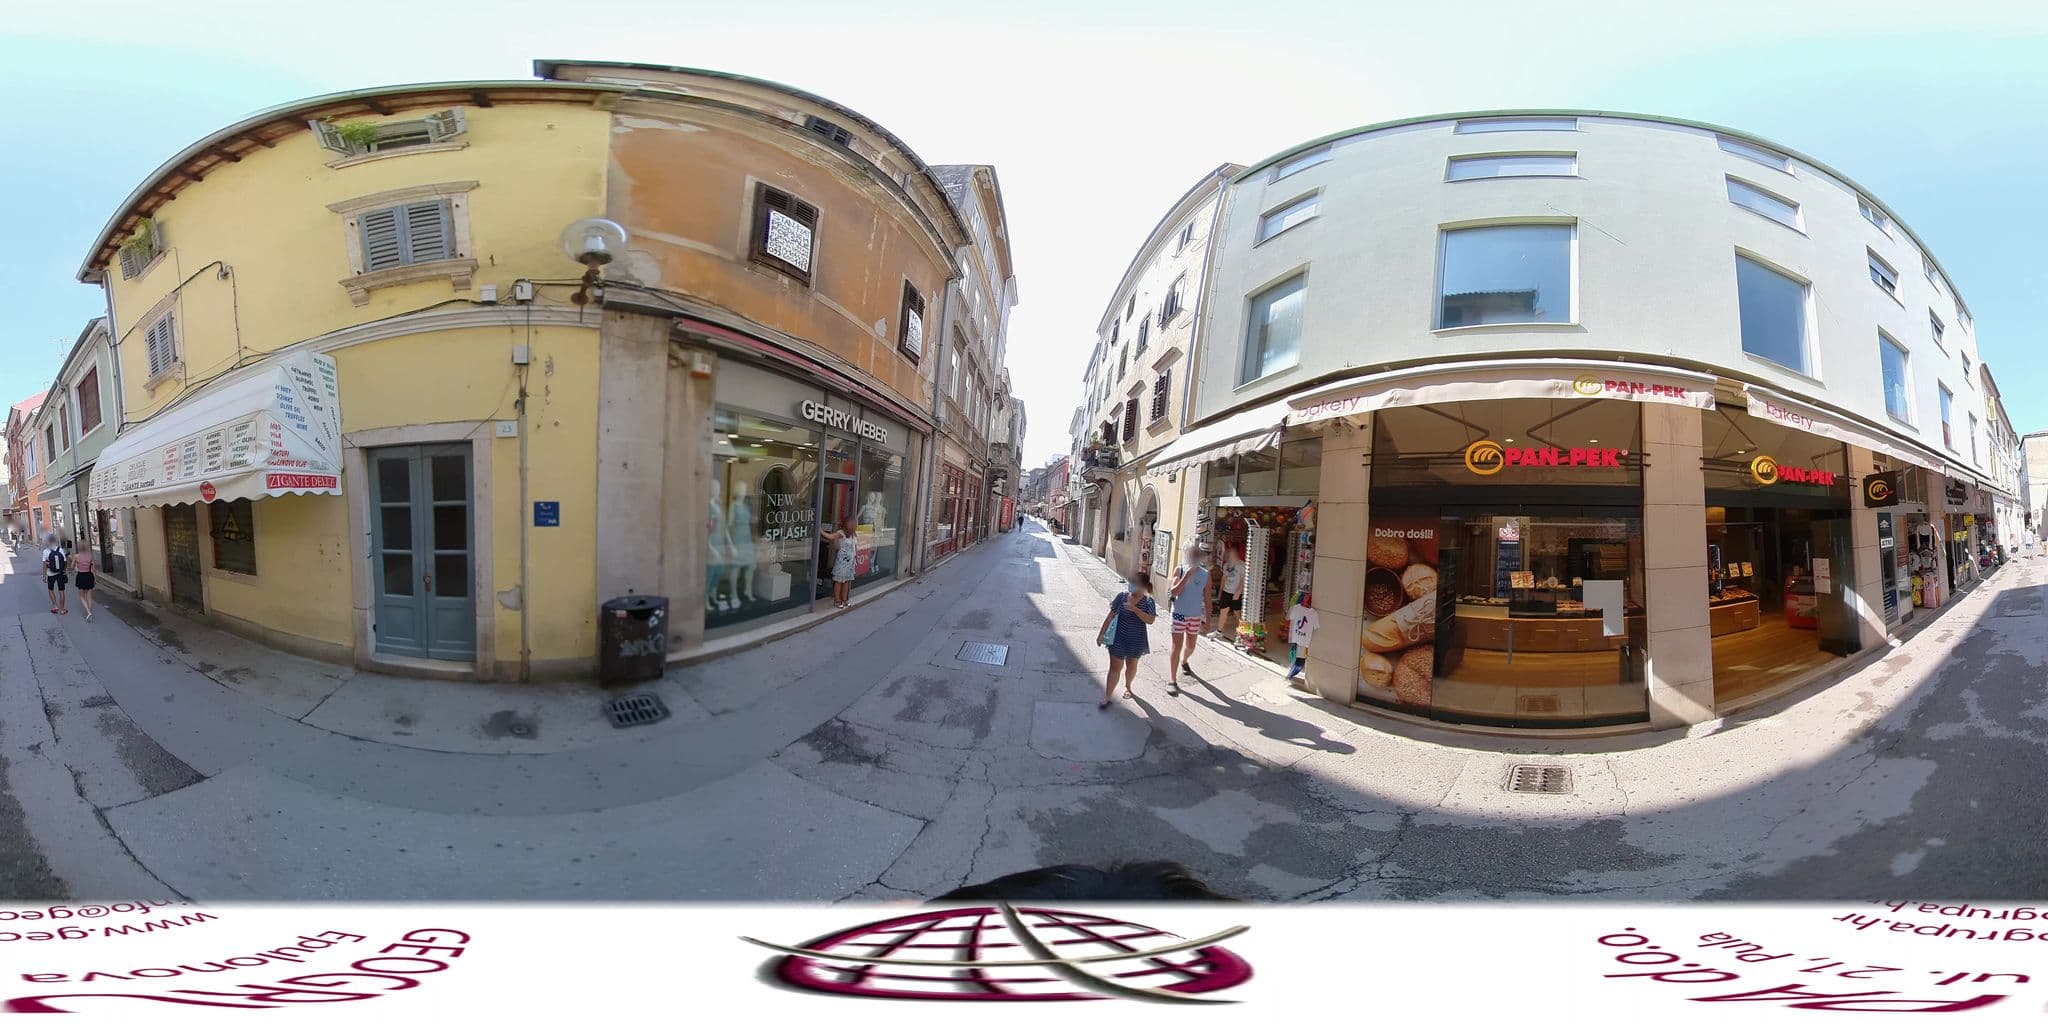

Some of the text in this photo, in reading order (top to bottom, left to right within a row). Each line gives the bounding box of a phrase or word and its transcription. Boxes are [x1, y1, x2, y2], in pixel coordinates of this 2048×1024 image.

[1605, 380, 1686, 399] PAN-PEK
[801, 399, 888, 444] GERRY WEBER
[1766, 400, 1814, 430] bakery
[1505, 448, 1620, 468] PAN-PEK
[269, 475, 310, 487] ZIGANTE
[1777, 464, 1834, 486] PAN-PEK
[766, 493, 794, 507] NEW
[765, 509, 814, 526] COLOUR
[765, 526, 808, 542] SPLASH
[1375, 528, 1434, 539] Dobro došli!
